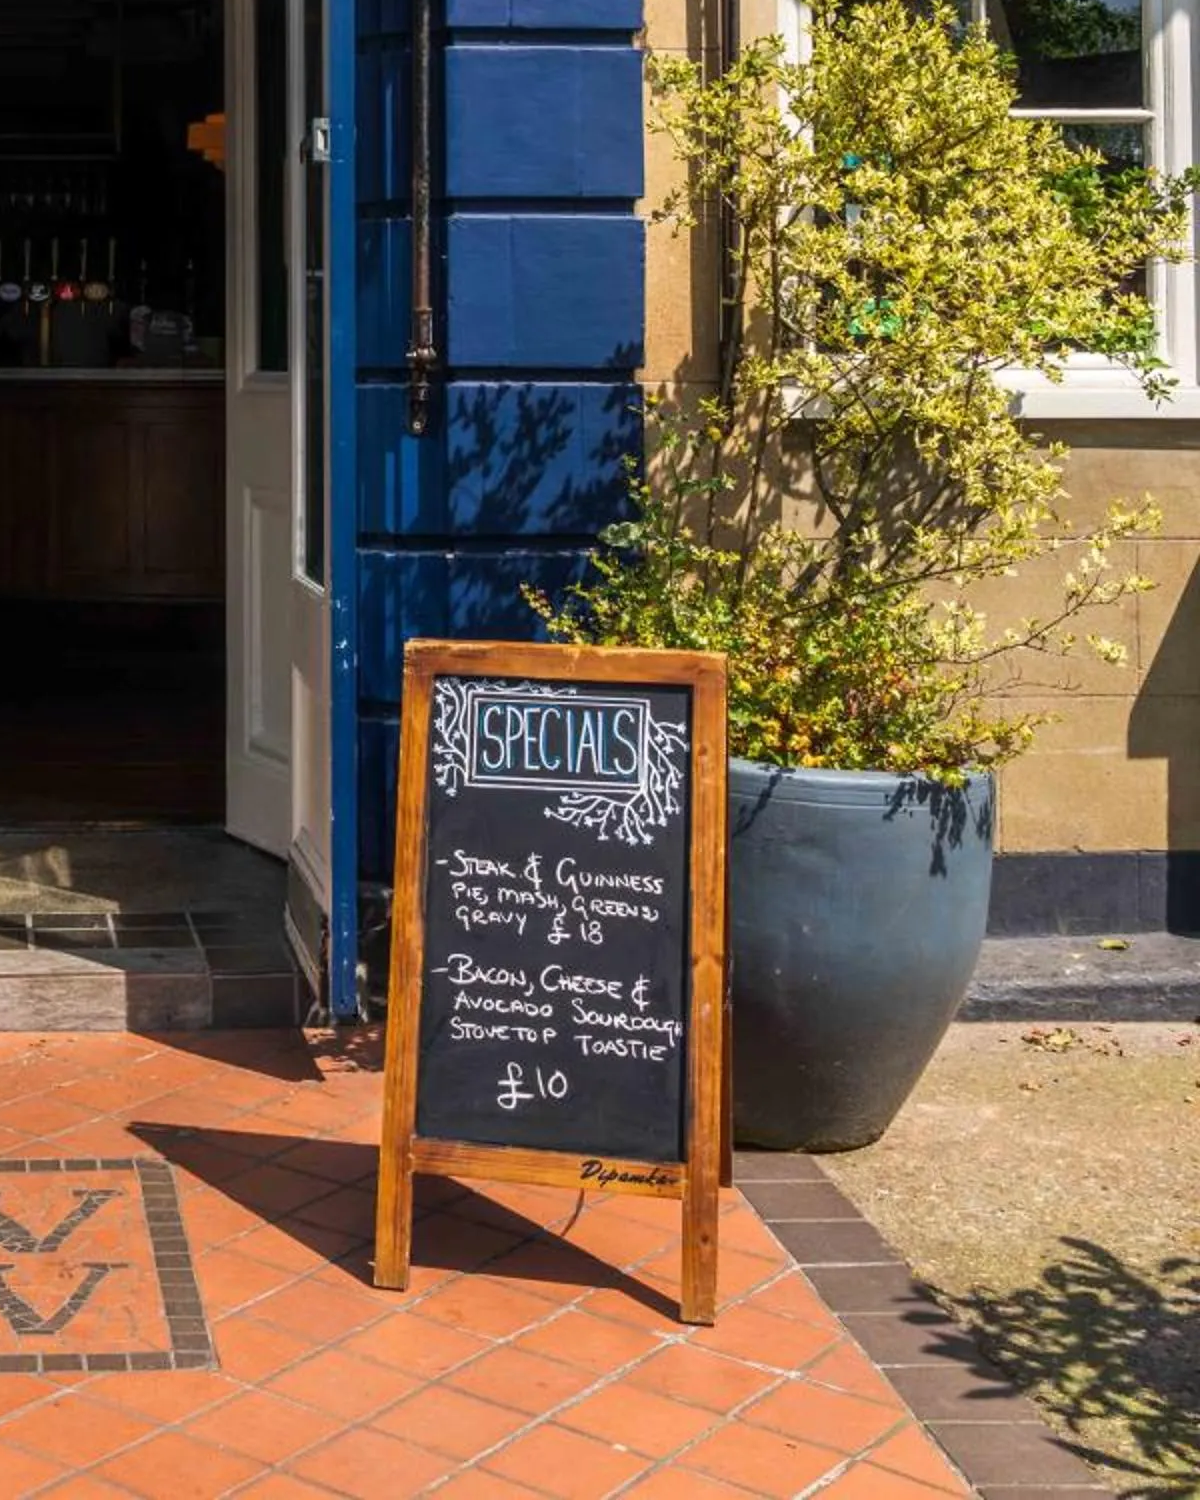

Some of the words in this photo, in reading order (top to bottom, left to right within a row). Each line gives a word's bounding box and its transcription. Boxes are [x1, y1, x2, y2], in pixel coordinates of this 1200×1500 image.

[482, 705, 638, 775] SPECIALS
[523, 852, 543, 890] &
[556, 857, 665, 895] GUINNESS
[455, 905, 528, 936] GRAVY
[540, 964, 623, 999] CHEESE
[630, 974, 651, 1012] &
[453, 991, 553, 1017] AVOCADO
[571, 998, 683, 1048] SOURDOUGH
[573, 1035, 668, 1062] TOASTIE
[496, 1061, 568, 1109] £10
